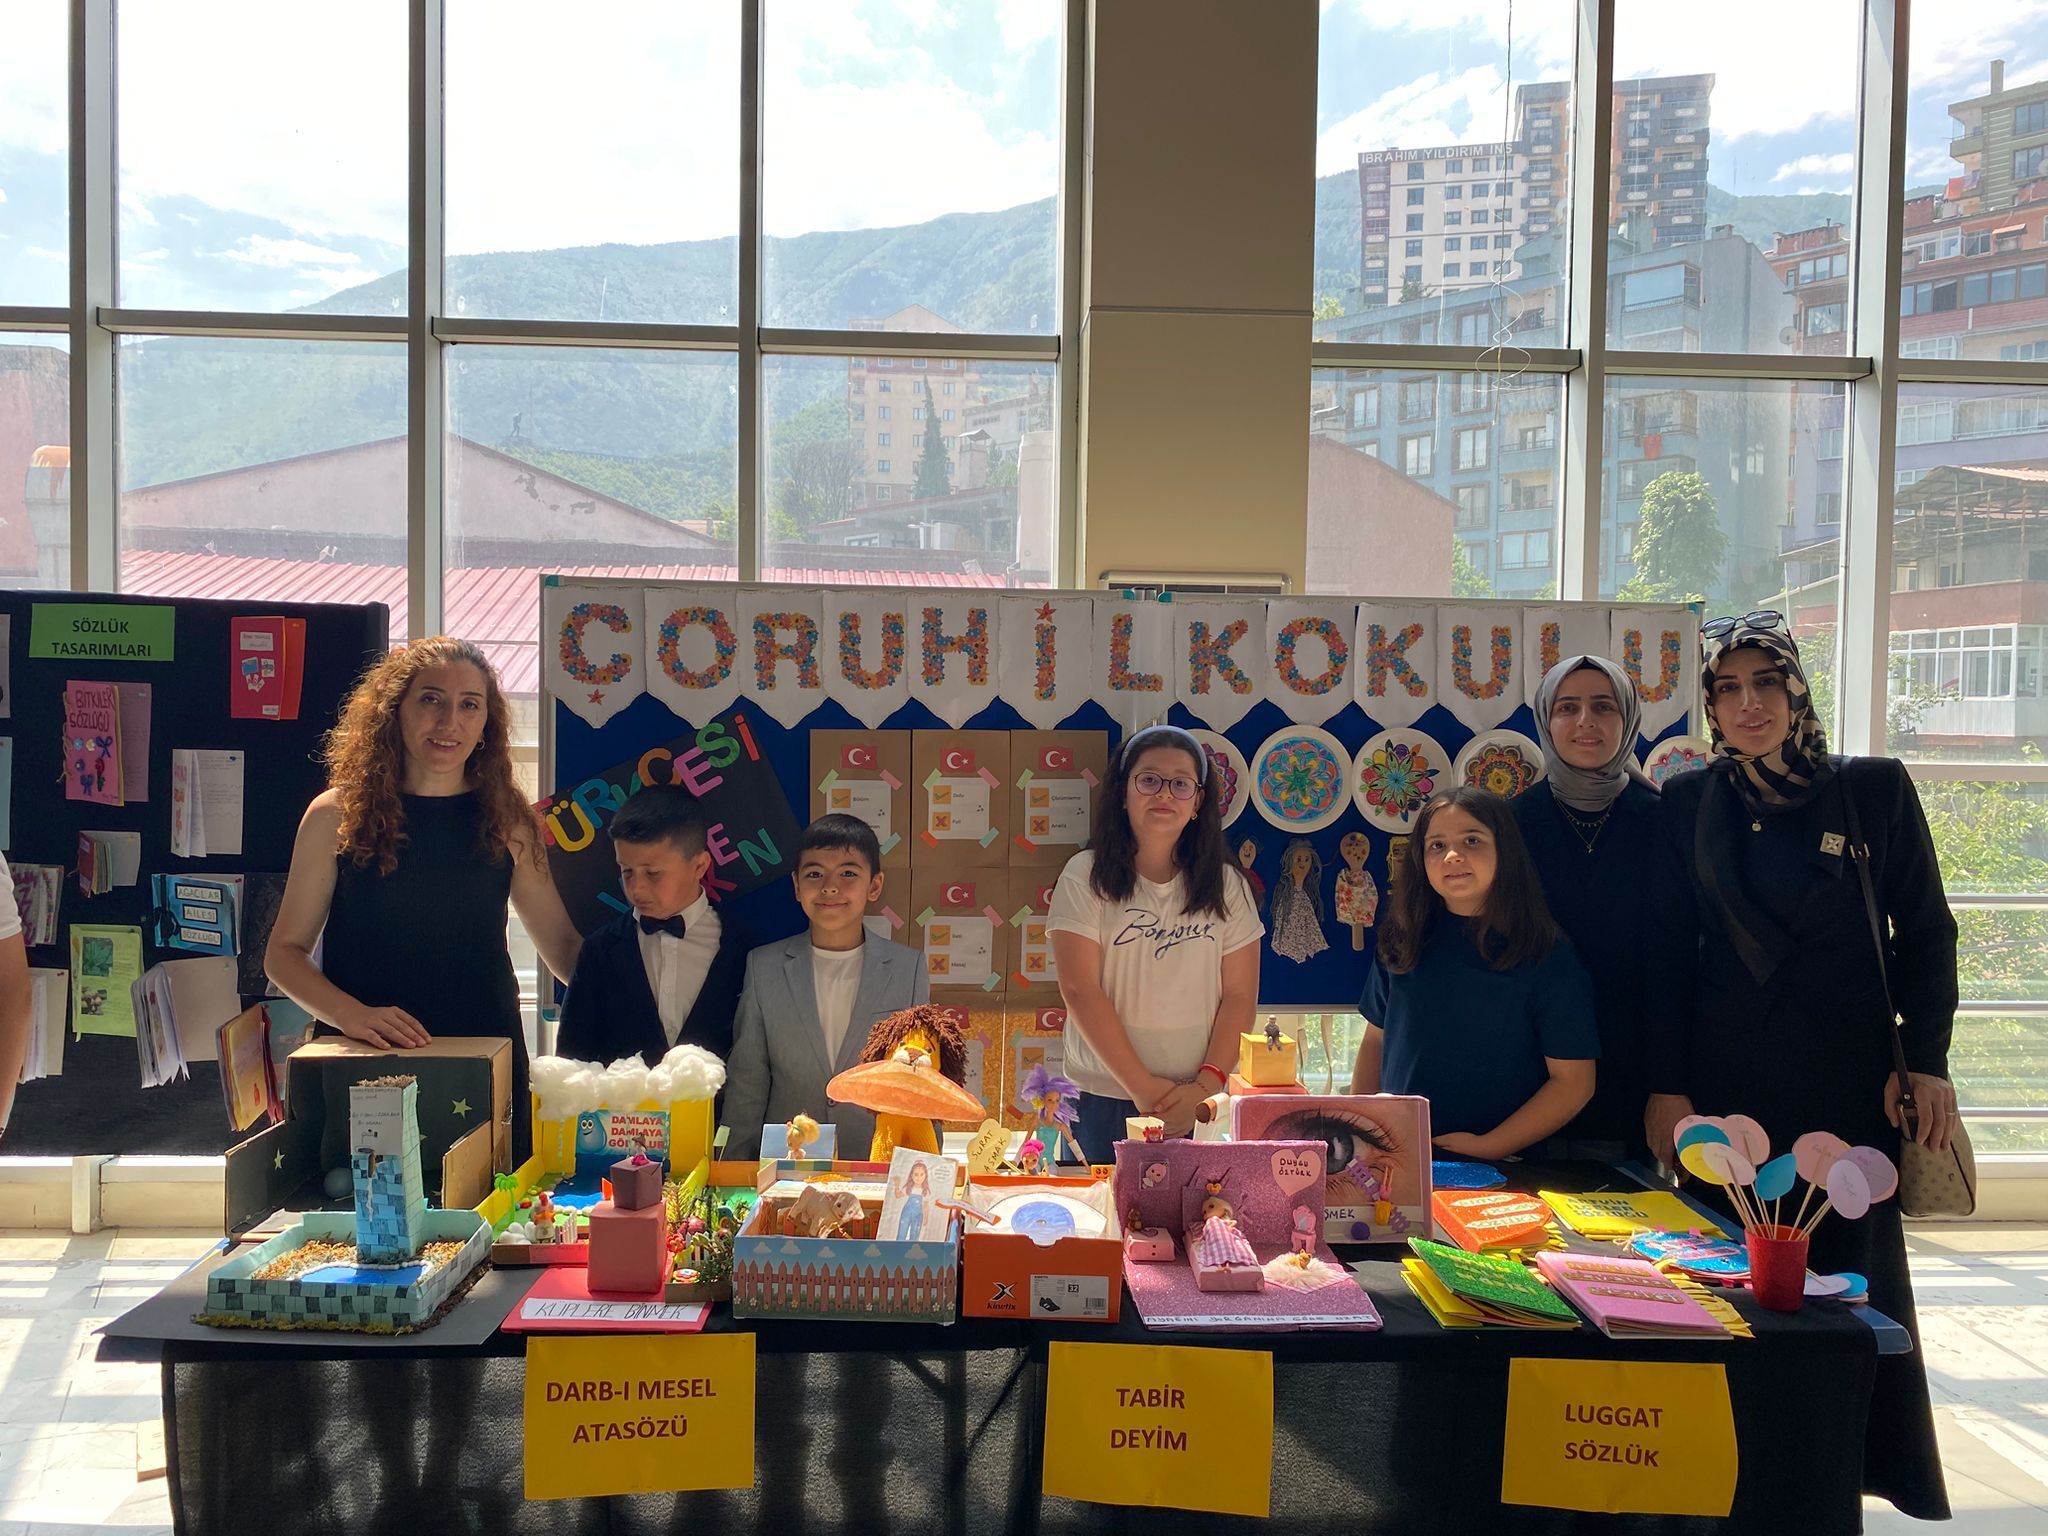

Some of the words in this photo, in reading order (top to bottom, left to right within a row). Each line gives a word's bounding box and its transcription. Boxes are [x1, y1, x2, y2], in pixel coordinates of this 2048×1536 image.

[1423, 146, 1484, 160] YILDIRIM
[72, 618, 129, 634] SÖZLÜK
[558, 602, 989, 706] ÇORUH
[1113, 908, 1215, 960] Bonjour
[971, 1129, 993, 1160] SURAT
[983, 1137, 1007, 1173] ASMAK
[546, 1381, 630, 1402] DARB-I
[638, 1378, 717, 1400] MESEL
[1116, 1384, 1186, 1409] TABİR
[1565, 1403, 1663, 1428] LUGGAT
[572, 1415, 688, 1443] ATASÖZÜ
[1111, 1425, 1187, 1451] DEYİM
[1564, 1440, 1659, 1467] SÖZLÜK
